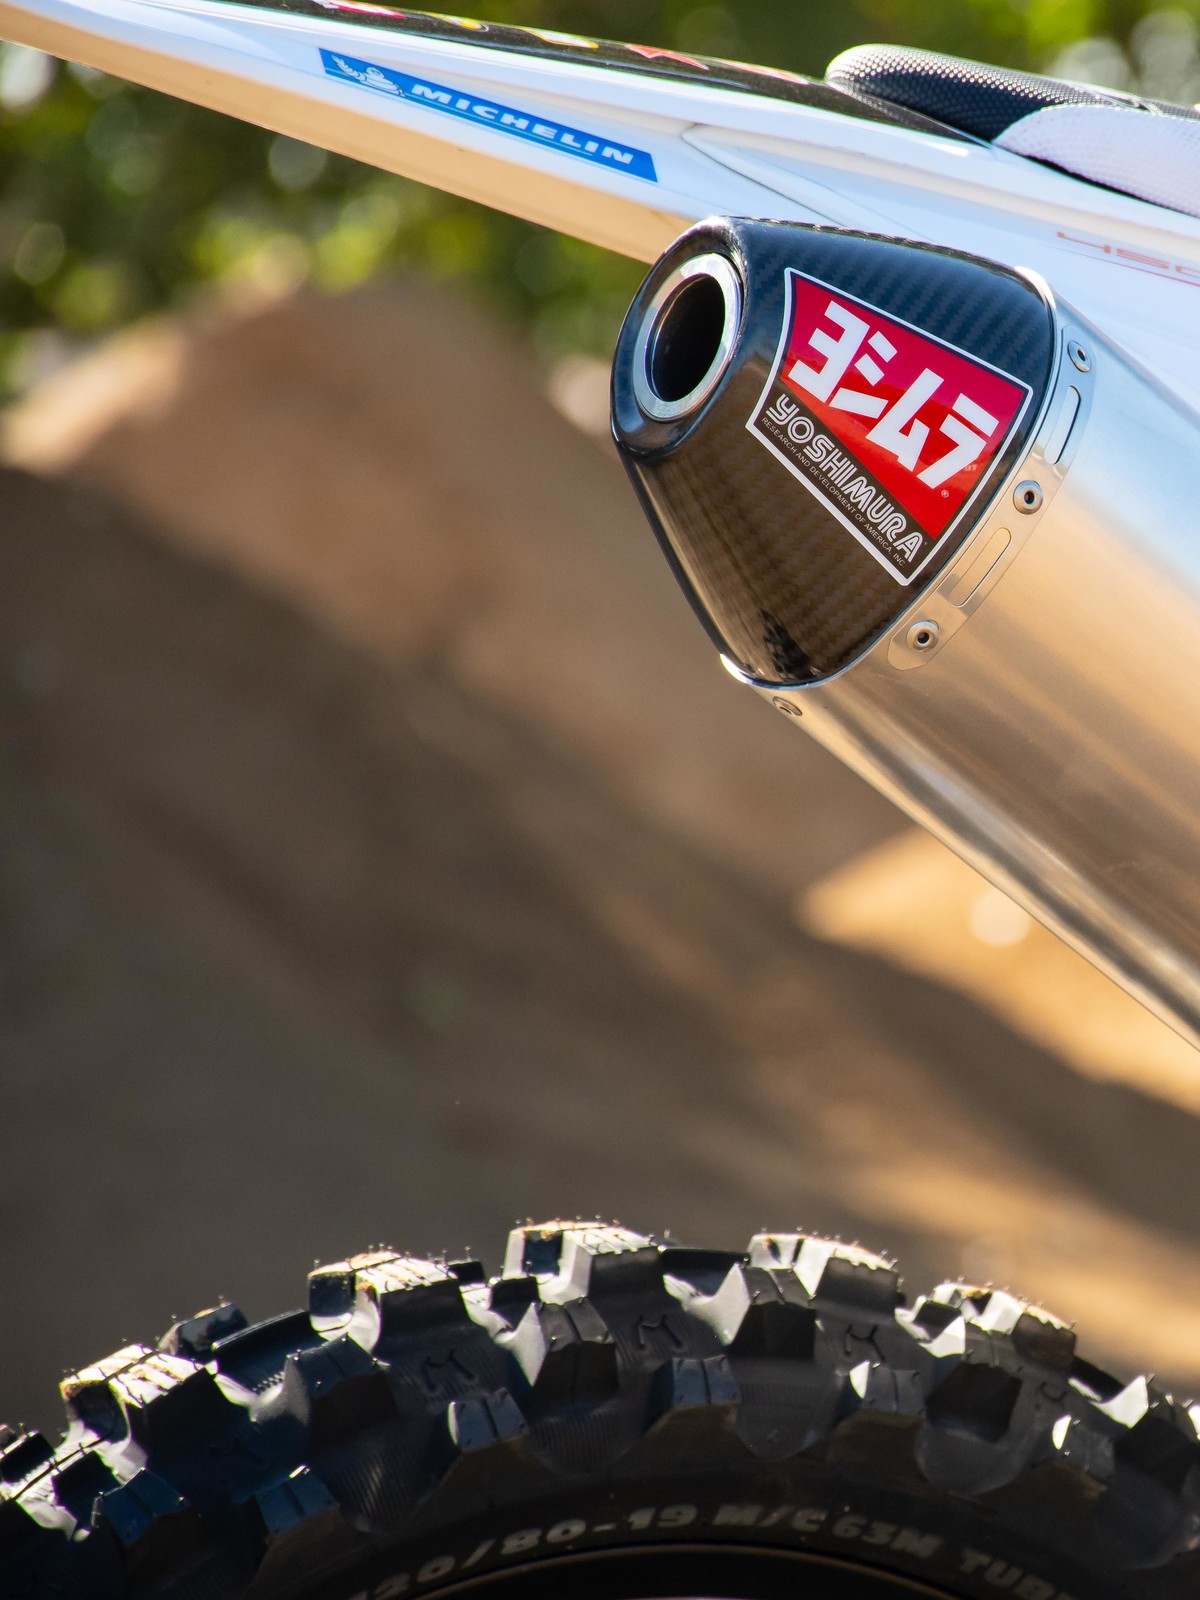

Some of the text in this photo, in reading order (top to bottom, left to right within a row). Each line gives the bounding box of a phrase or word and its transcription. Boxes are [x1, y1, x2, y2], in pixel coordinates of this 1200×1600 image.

[411, 84, 633, 165] MICHELIN
[761, 417, 798, 454] RESEARCH
[795, 452, 811, 467] AND
[809, 466, 857, 514] DEVELOPMENT
[854, 513, 866, 524] OF
[765, 393, 924, 563] YOSHIMURA
[711, 1503, 828, 1532] M/C
[831, 1514, 945, 1560] 63M
[959, 1546, 1080, 1600] TUB
